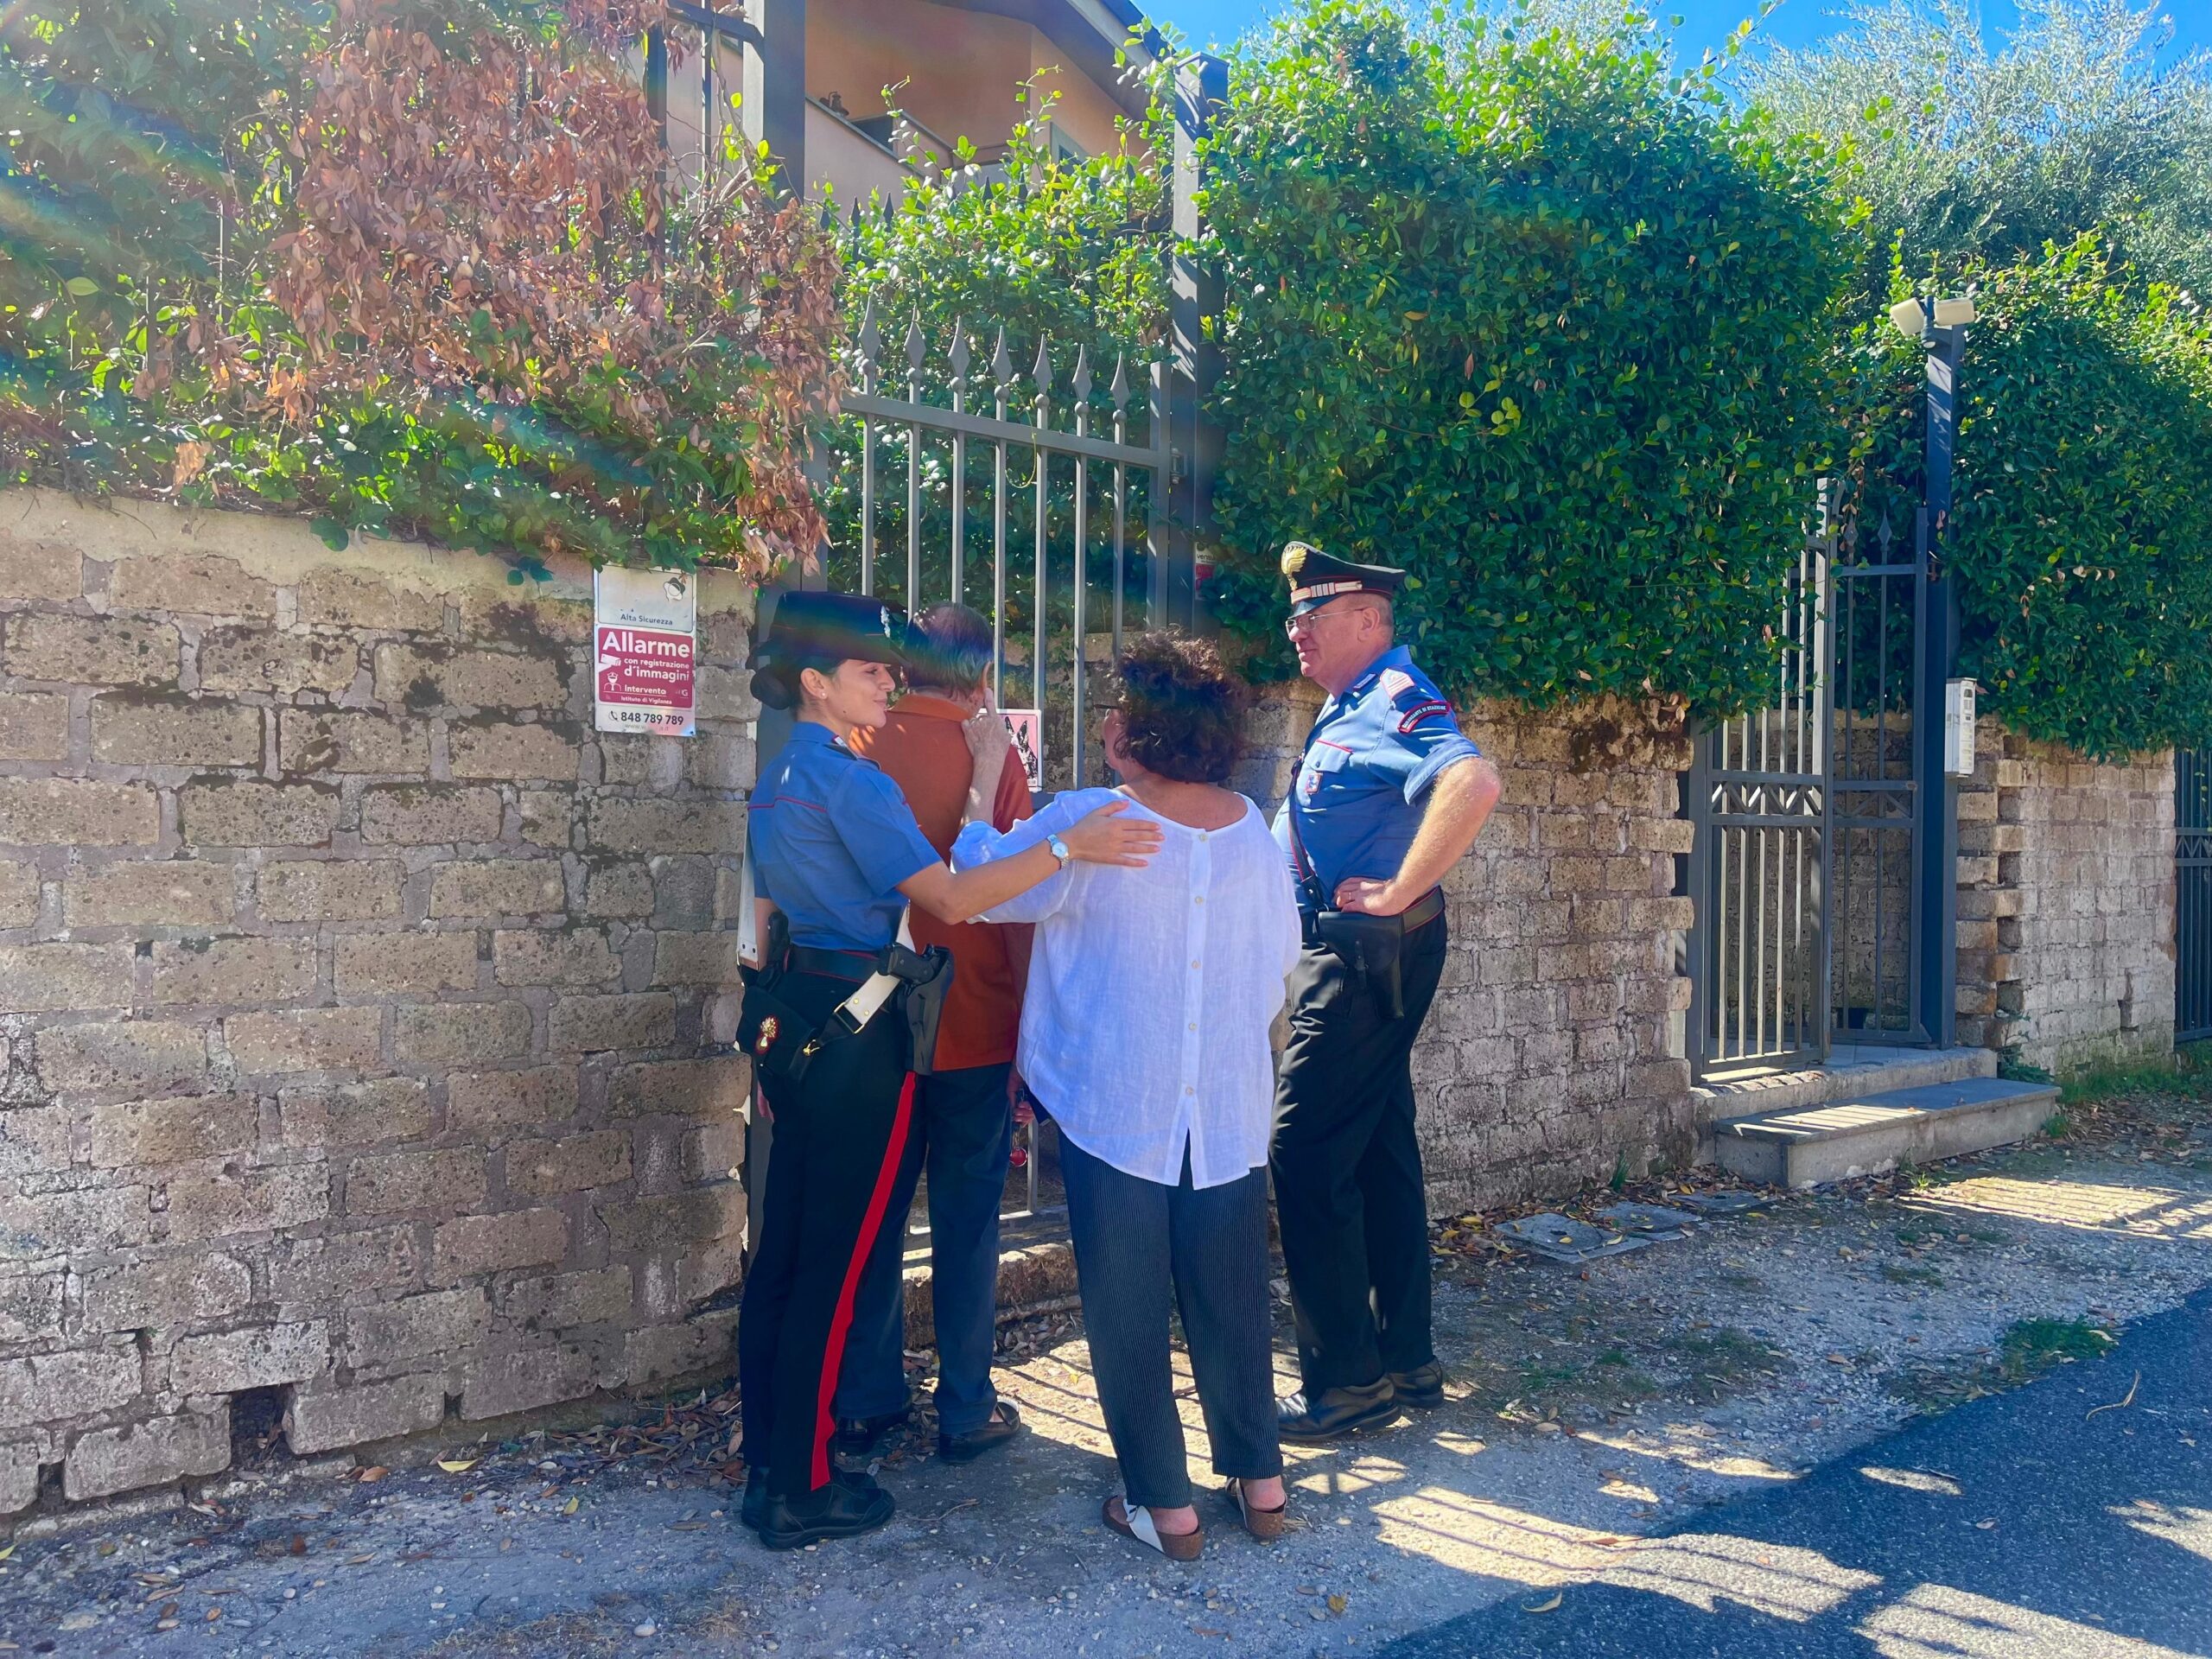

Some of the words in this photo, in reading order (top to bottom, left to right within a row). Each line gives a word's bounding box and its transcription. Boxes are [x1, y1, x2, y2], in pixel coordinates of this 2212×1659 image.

[639, 615, 673, 626] Sicurezza
[602, 632, 690, 658] Allarme
[640, 659, 690, 669] registrazione
[625, 684, 666, 696] Intervento
[620, 712, 641, 722] 848
[644, 714, 663, 724] 789
[665, 715, 683, 725] 789
